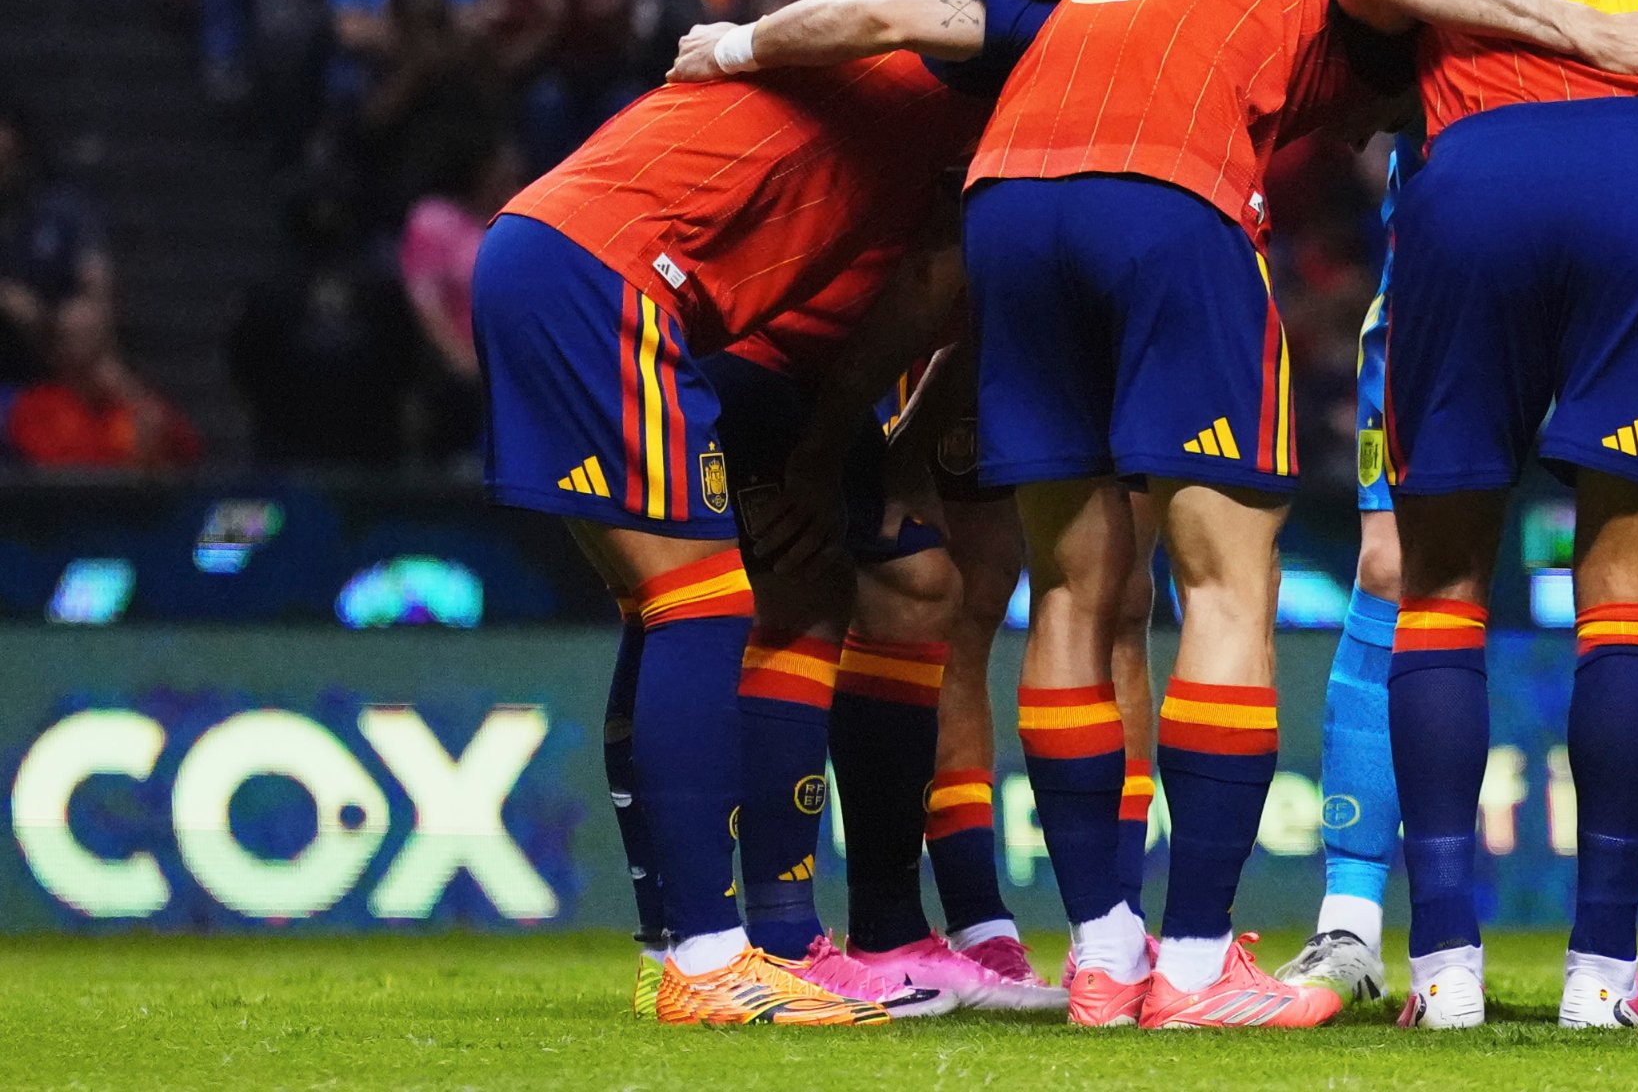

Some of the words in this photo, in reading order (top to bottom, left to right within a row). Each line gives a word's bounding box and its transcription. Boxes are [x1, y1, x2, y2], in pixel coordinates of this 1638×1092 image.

[805, 784, 824, 795] RF
[803, 795, 823, 806] EF
[12, 704, 559, 919] COX
